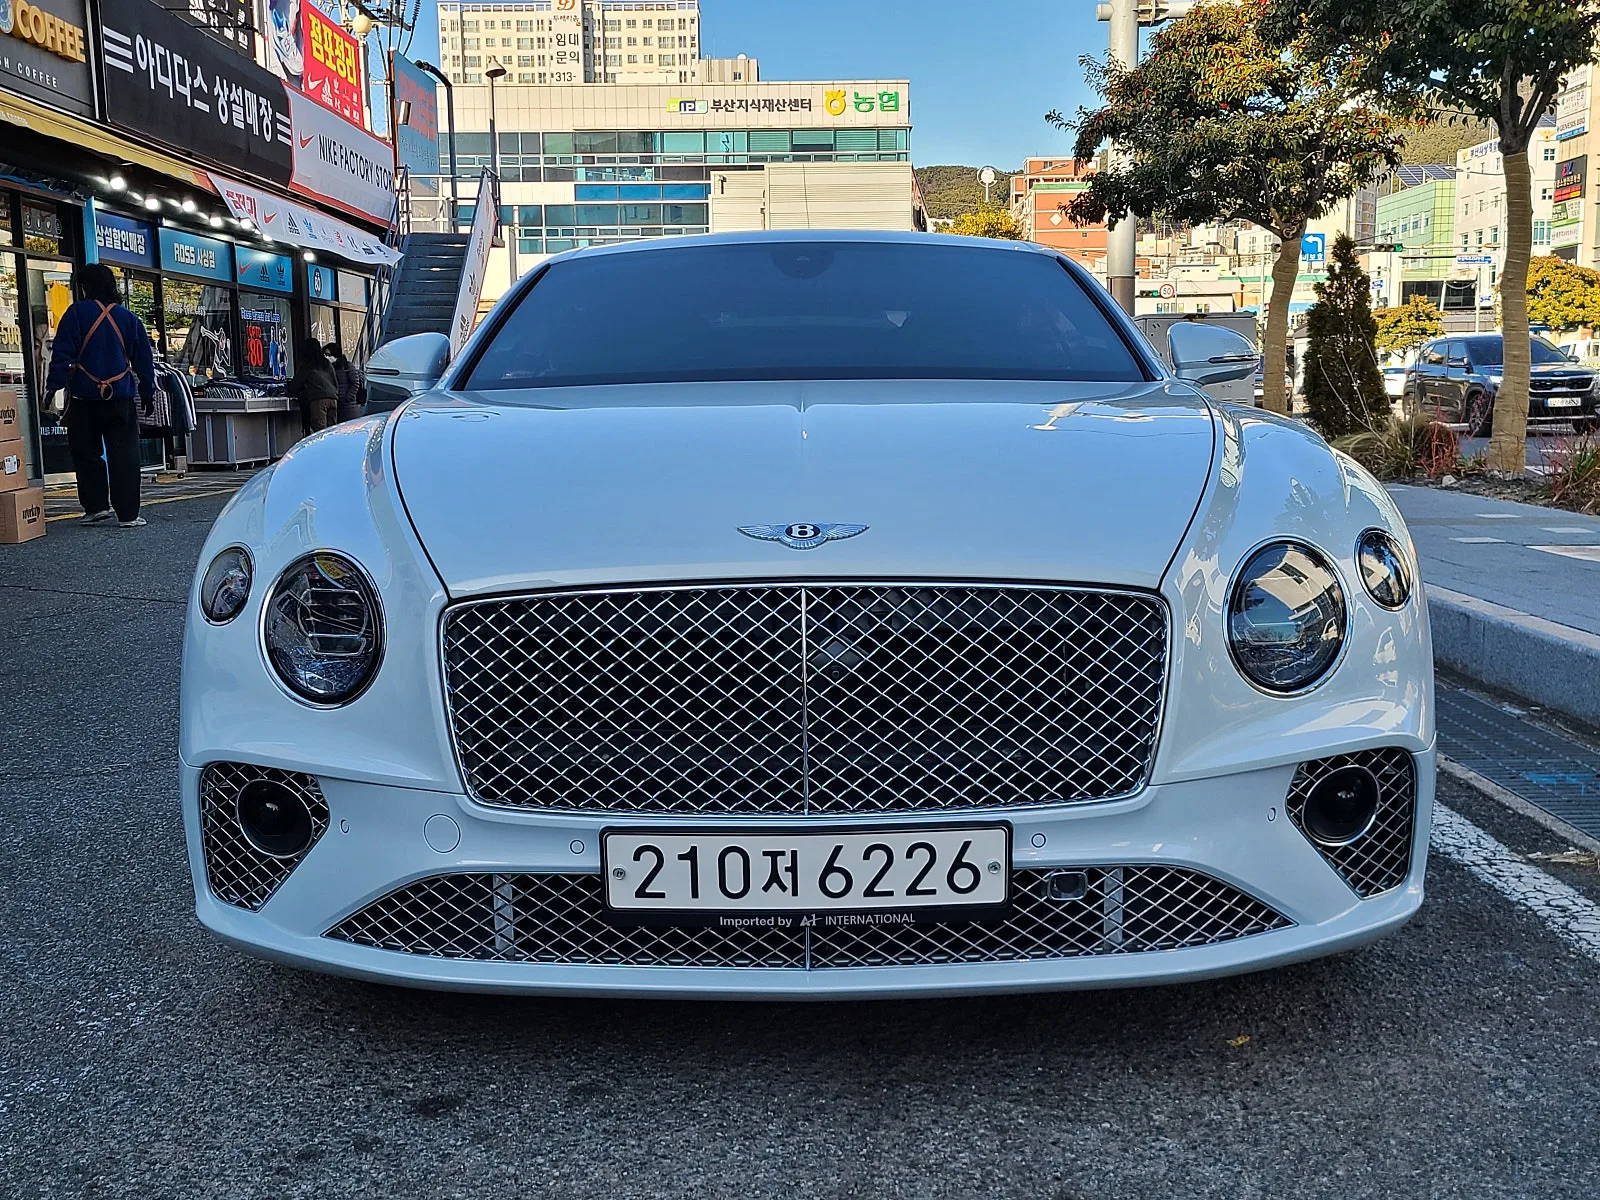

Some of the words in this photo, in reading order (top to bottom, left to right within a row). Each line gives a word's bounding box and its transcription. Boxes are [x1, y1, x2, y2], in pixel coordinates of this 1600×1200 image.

[16, 0, 86, 63] COFFEE
[555, 32, 580, 47] 임대
[308, 13, 357, 87] 점포정리
[555, 50, 580, 65] 문의
[17, 62, 57, 88] COFFEE
[135, 34, 210, 113] 아디다스
[214, 75, 273, 142] 상설매장
[555, 71, 576, 82] 313-
[711, 98, 812, 113] 부산지식재산센터
[853, 91, 900, 113] 농협
[318, 134, 338, 166] NIKE
[340, 144, 374, 184] FACTORY
[376, 164, 394, 194] STOR
[96, 224, 145, 255] 상설할인매장
[173, 242, 195, 264] ROSS
[197, 247, 216, 269] 사상점
[1162, 287, 1172, 296] 50
[248, 338, 264, 368] 80
[791, 524, 815, 538] B
[632, 844, 798, 899] 210저
[818, 840, 981, 899] 6226
[719, 915, 776, 928] Imported
[778, 915, 793, 928] by
[825, 913, 916, 926] INTERNATIONAL
